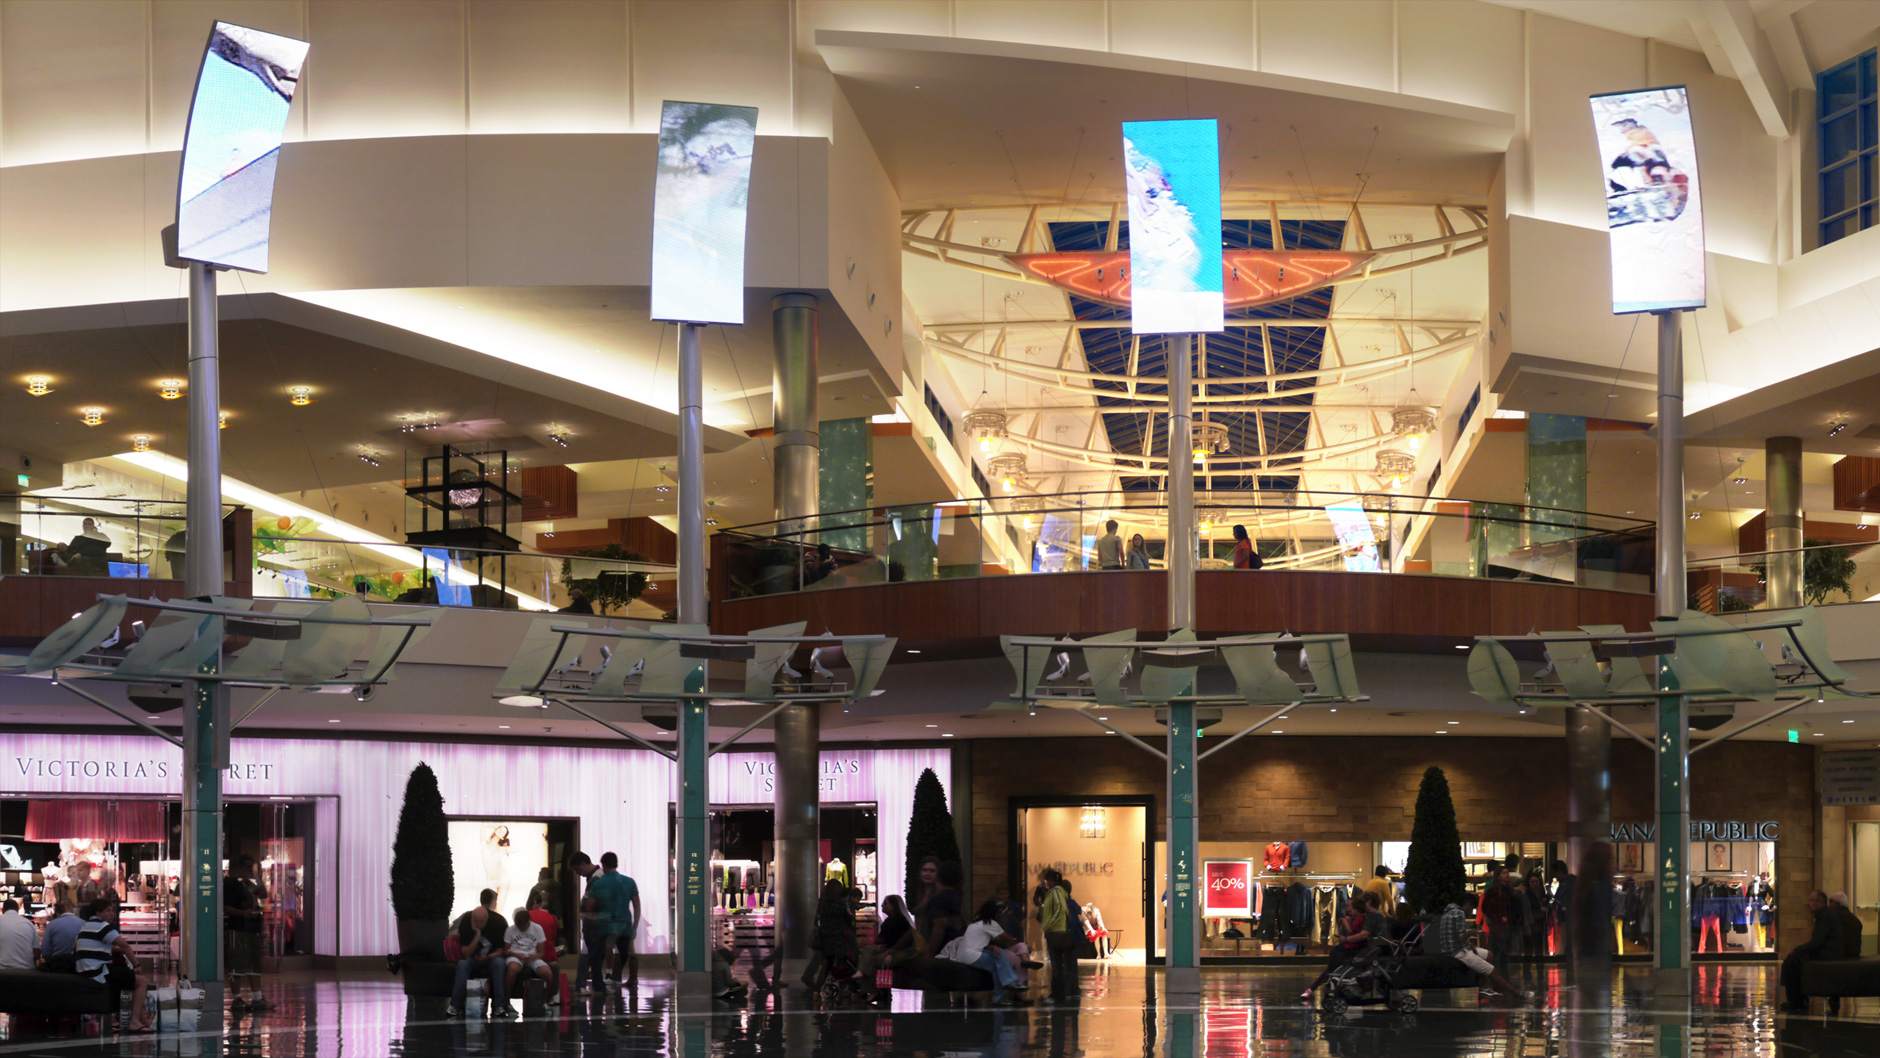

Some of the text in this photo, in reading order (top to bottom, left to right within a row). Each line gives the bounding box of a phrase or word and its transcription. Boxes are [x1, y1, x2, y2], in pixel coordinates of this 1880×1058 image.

[16, 758, 168, 778] VICTORIA'S
[744, 759, 859, 776] VICIA'S
[764, 778, 837, 793] SET
[1689, 820, 1780, 841] EPUBLIC
[1211, 877, 1245, 891] 40%
[875, 976, 894, 985] SALE
